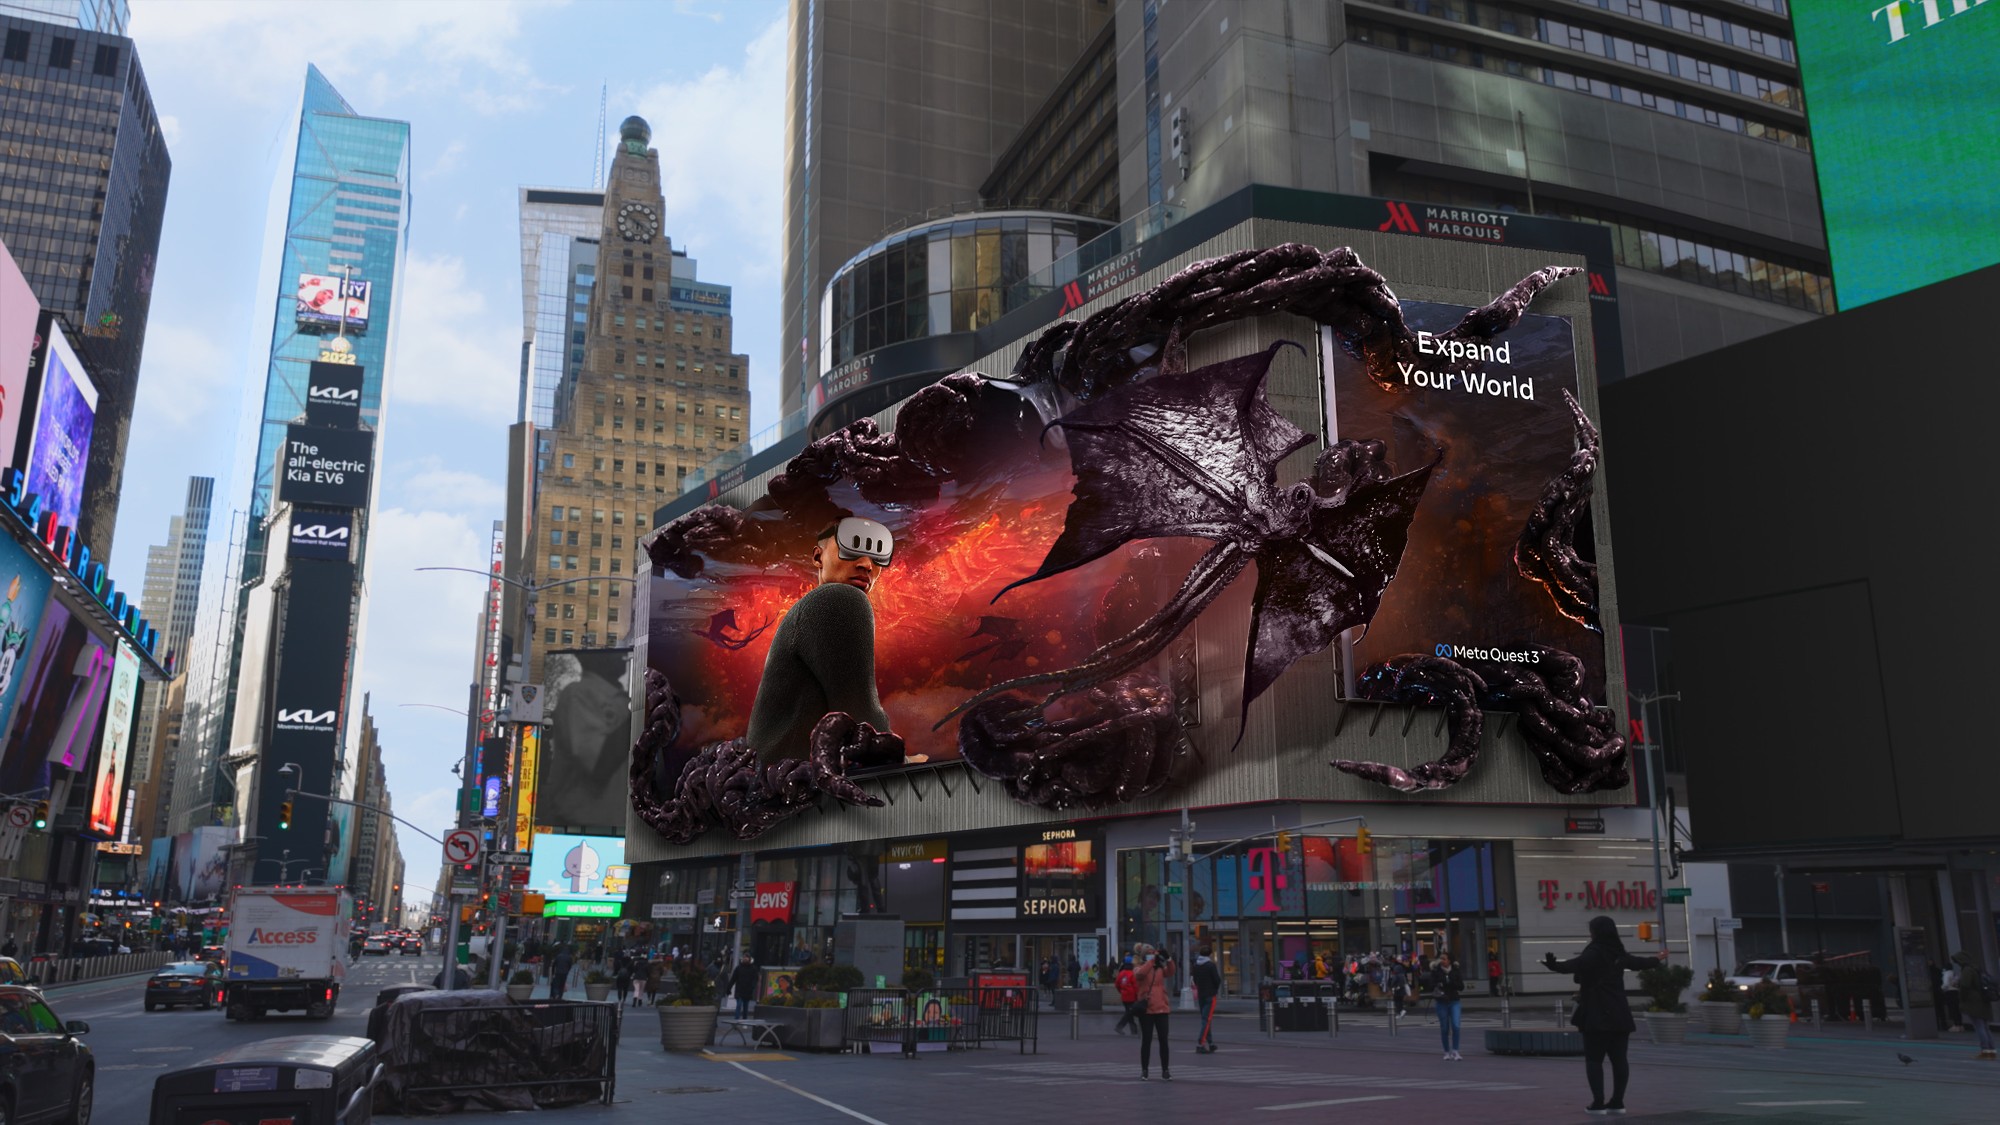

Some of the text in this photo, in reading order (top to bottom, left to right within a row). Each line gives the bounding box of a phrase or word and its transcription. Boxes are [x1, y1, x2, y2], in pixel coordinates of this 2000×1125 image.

[1427, 208, 1509, 227] MARRIOTT
[1428, 222, 1501, 240] MARQUIS
[1088, 247, 1142, 284] MARRIOTT
[1088, 265, 1137, 297] MARQUIS
[1418, 330, 1511, 365] Expand
[321, 350, 356, 365] 2022
[827, 354, 875, 384] MARRIOTT
[827, 371, 868, 399] MARQUIS
[1398, 361, 1535, 400] Your World
[291, 441, 319, 455] The
[288, 456, 366, 473] all-electric
[720, 463, 747, 482] MARRIOTT
[287, 468, 344, 485] Kia EV6
[720, 475, 743, 494] MARQUIS
[1454, 645, 1540, 663] Meta Quest 3
[276, 723, 304, 731] Movement
[314, 725, 334, 733] inspires
[1042, 829, 1076, 841] SEPHORA
[891, 845, 925, 858] INVICTA
[566, 904, 589, 913] NEW
[590, 905, 614, 914] YORK
[1023, 898, 1087, 915] SEPHORA
[247, 927, 317, 945] Access
